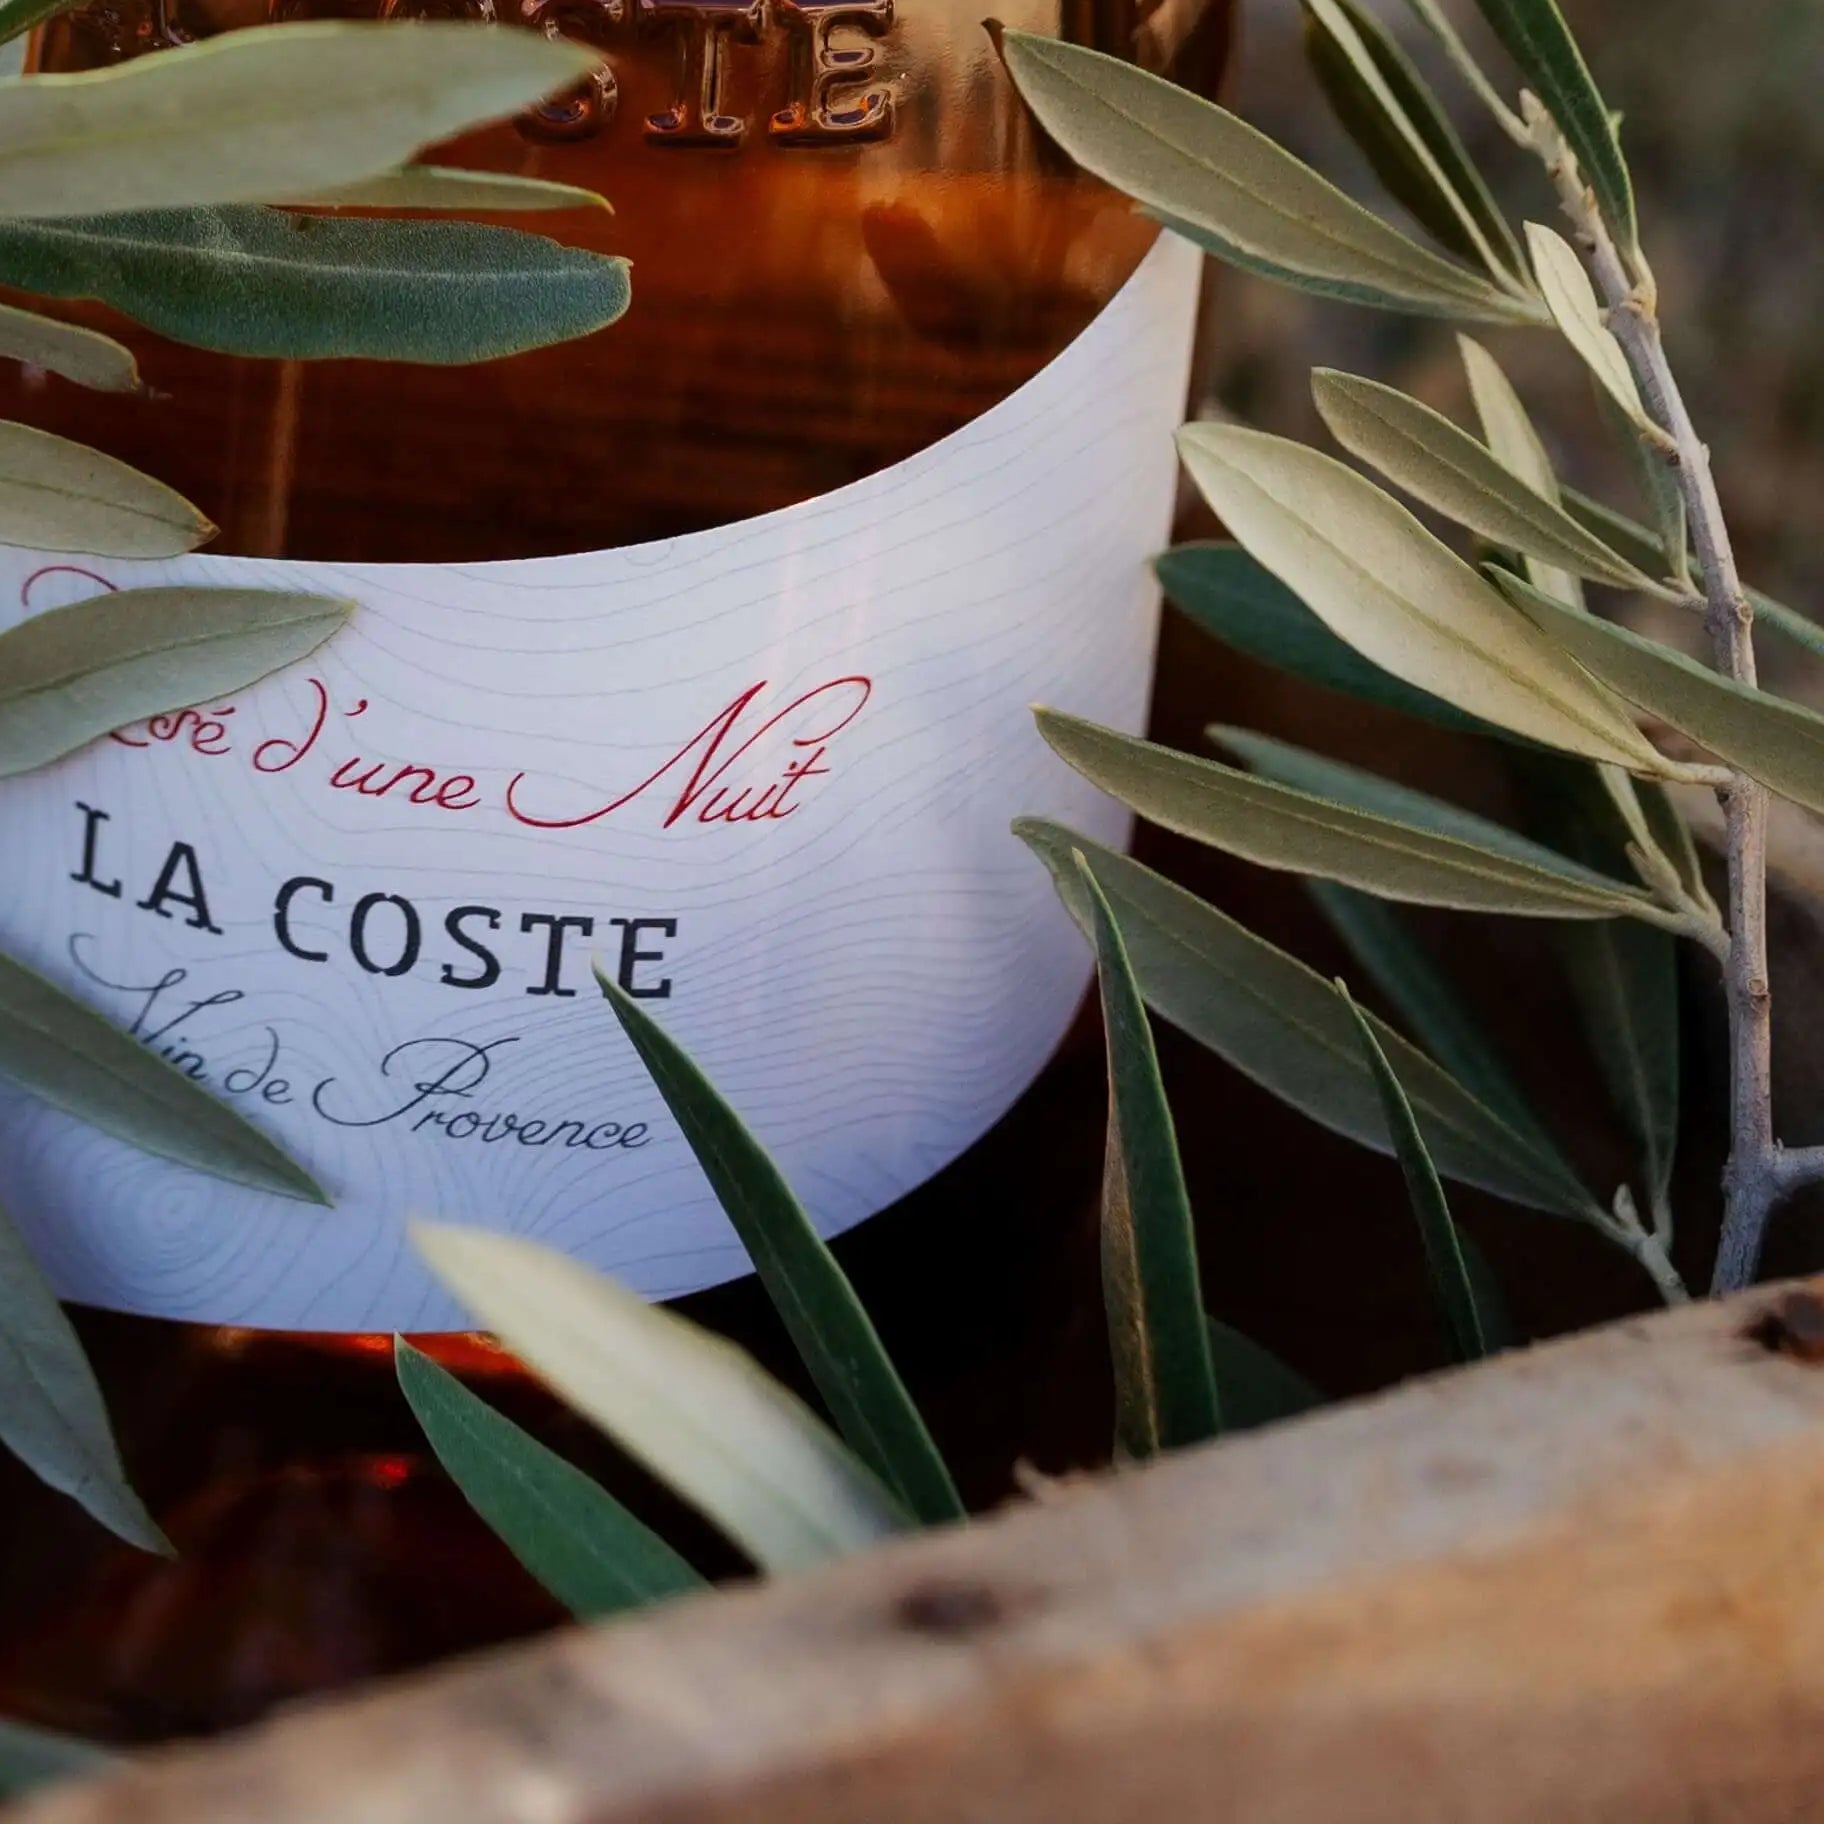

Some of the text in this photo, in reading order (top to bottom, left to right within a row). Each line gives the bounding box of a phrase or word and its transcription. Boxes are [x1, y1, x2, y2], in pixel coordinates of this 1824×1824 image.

[505, 674, 873, 830] Nuit
[68, 800, 679, 1000] LA COSTE
[224, 1025, 294, 1105] de
[310, 1035, 656, 1152] Provence
